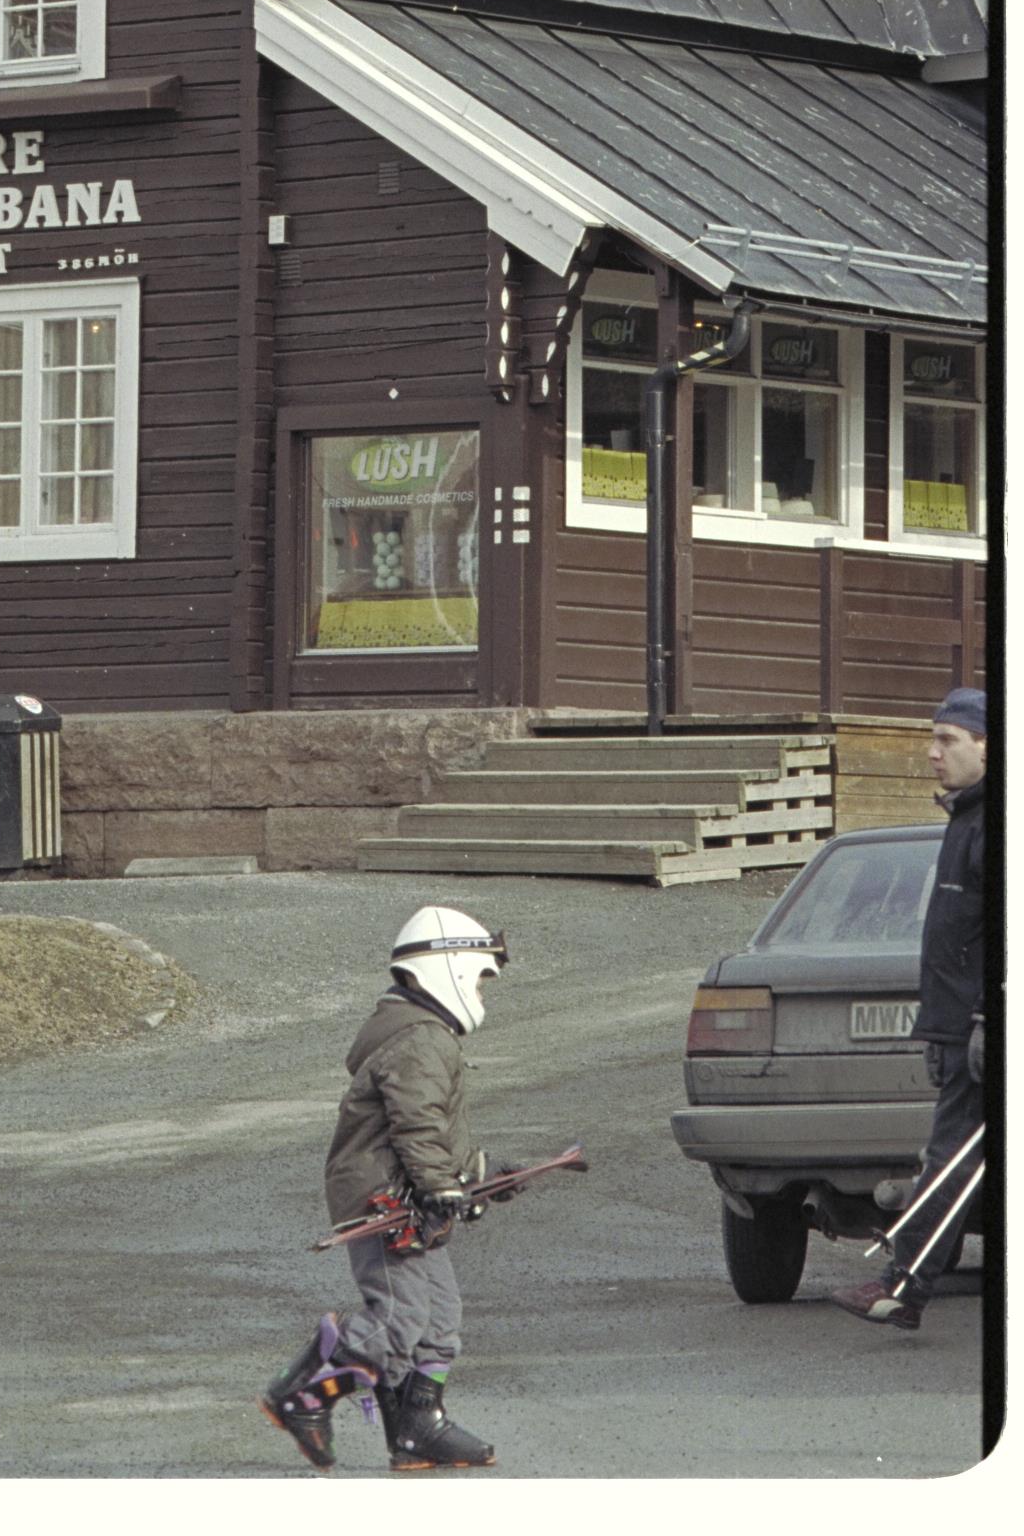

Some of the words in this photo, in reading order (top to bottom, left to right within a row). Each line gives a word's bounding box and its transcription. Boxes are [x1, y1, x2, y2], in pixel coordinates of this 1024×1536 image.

[593, 319, 636, 343] LUSH
[774, 340, 814, 363] LUSH
[912, 355, 952, 378] LUSH
[356, 437, 439, 481] LUSH
[322, 497, 355, 509] FRESH
[356, 494, 414, 507] HANDMADE
[416, 490, 474, 504] COSMETICS
